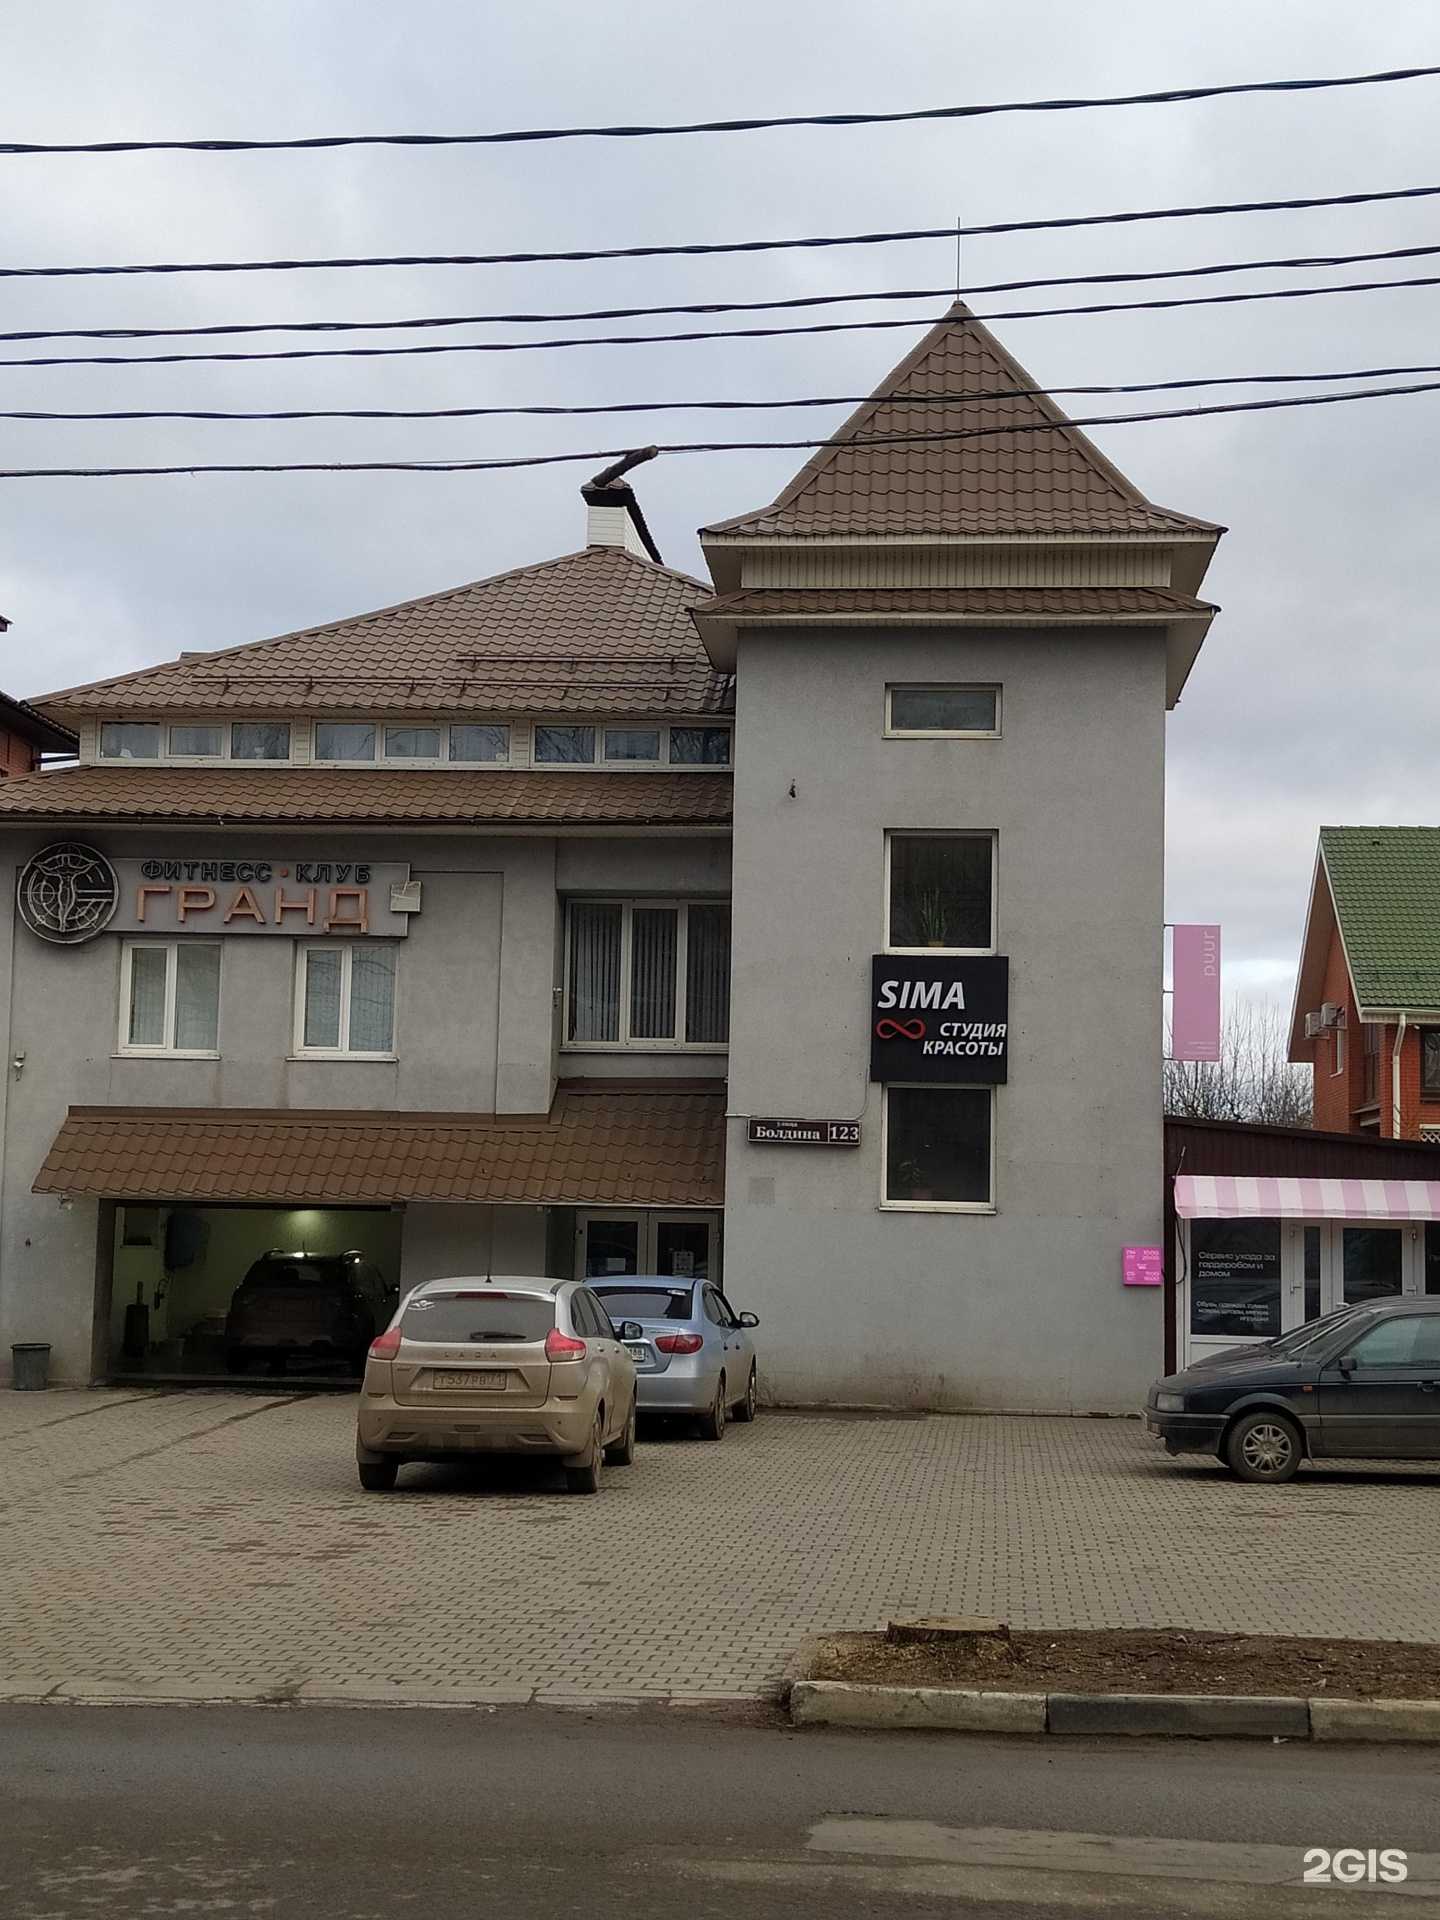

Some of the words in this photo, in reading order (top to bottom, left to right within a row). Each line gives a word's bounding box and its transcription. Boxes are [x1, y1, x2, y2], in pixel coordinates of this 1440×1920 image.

[141, 861, 272, 882] ФИТНЕСС
[296, 864, 370, 884] КЛУБ
[136, 885, 368, 934] ГРАНД
[877, 980, 965, 1010] SIMA
[940, 1022, 1007, 1040] СТУДИЯ
[922, 1041, 1004, 1056] КРАСОТЫ
[756, 1126, 821, 1140] Болдина
[831, 1126, 859, 1140] 123
